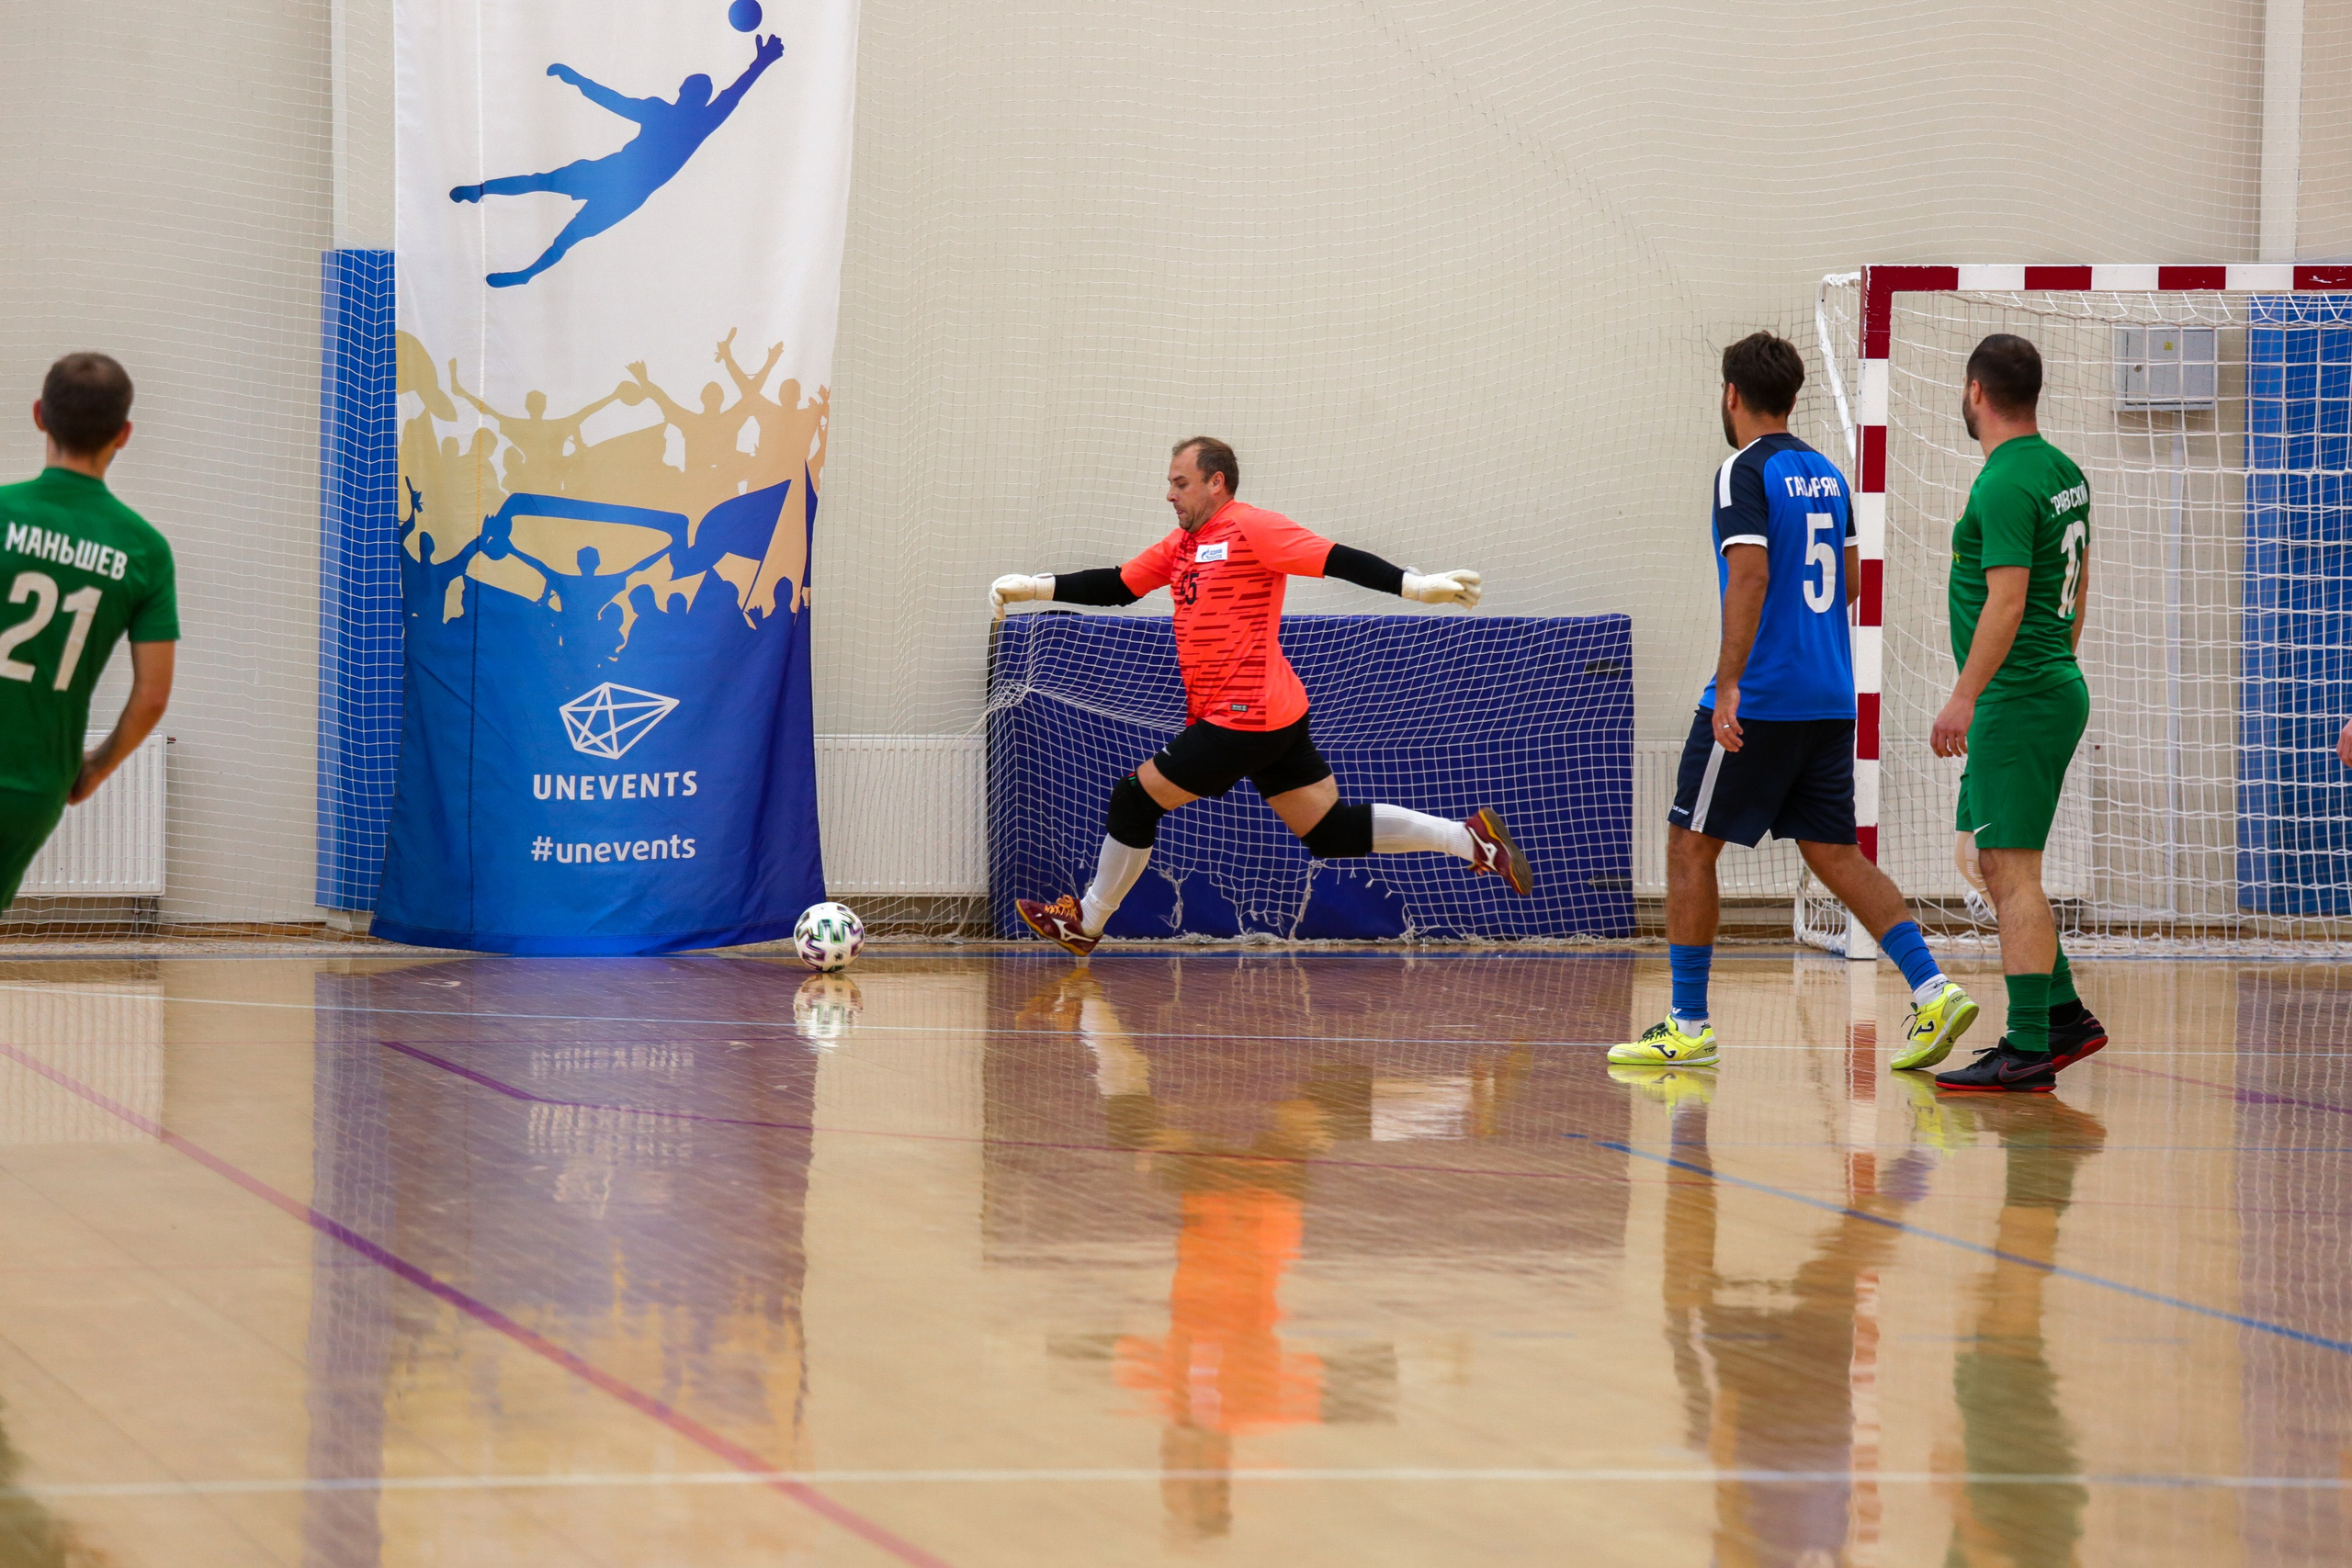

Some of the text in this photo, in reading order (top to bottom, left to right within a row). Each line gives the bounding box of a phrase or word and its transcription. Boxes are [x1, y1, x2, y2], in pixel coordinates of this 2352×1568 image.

[5, 521, 128, 581] МАНЬШЕВ
[1803, 513, 1837, 614] 5
[0, 570, 103, 692] 21
[533, 771, 697, 801] UNEVENTS
[531, 834, 696, 863] #unevents
